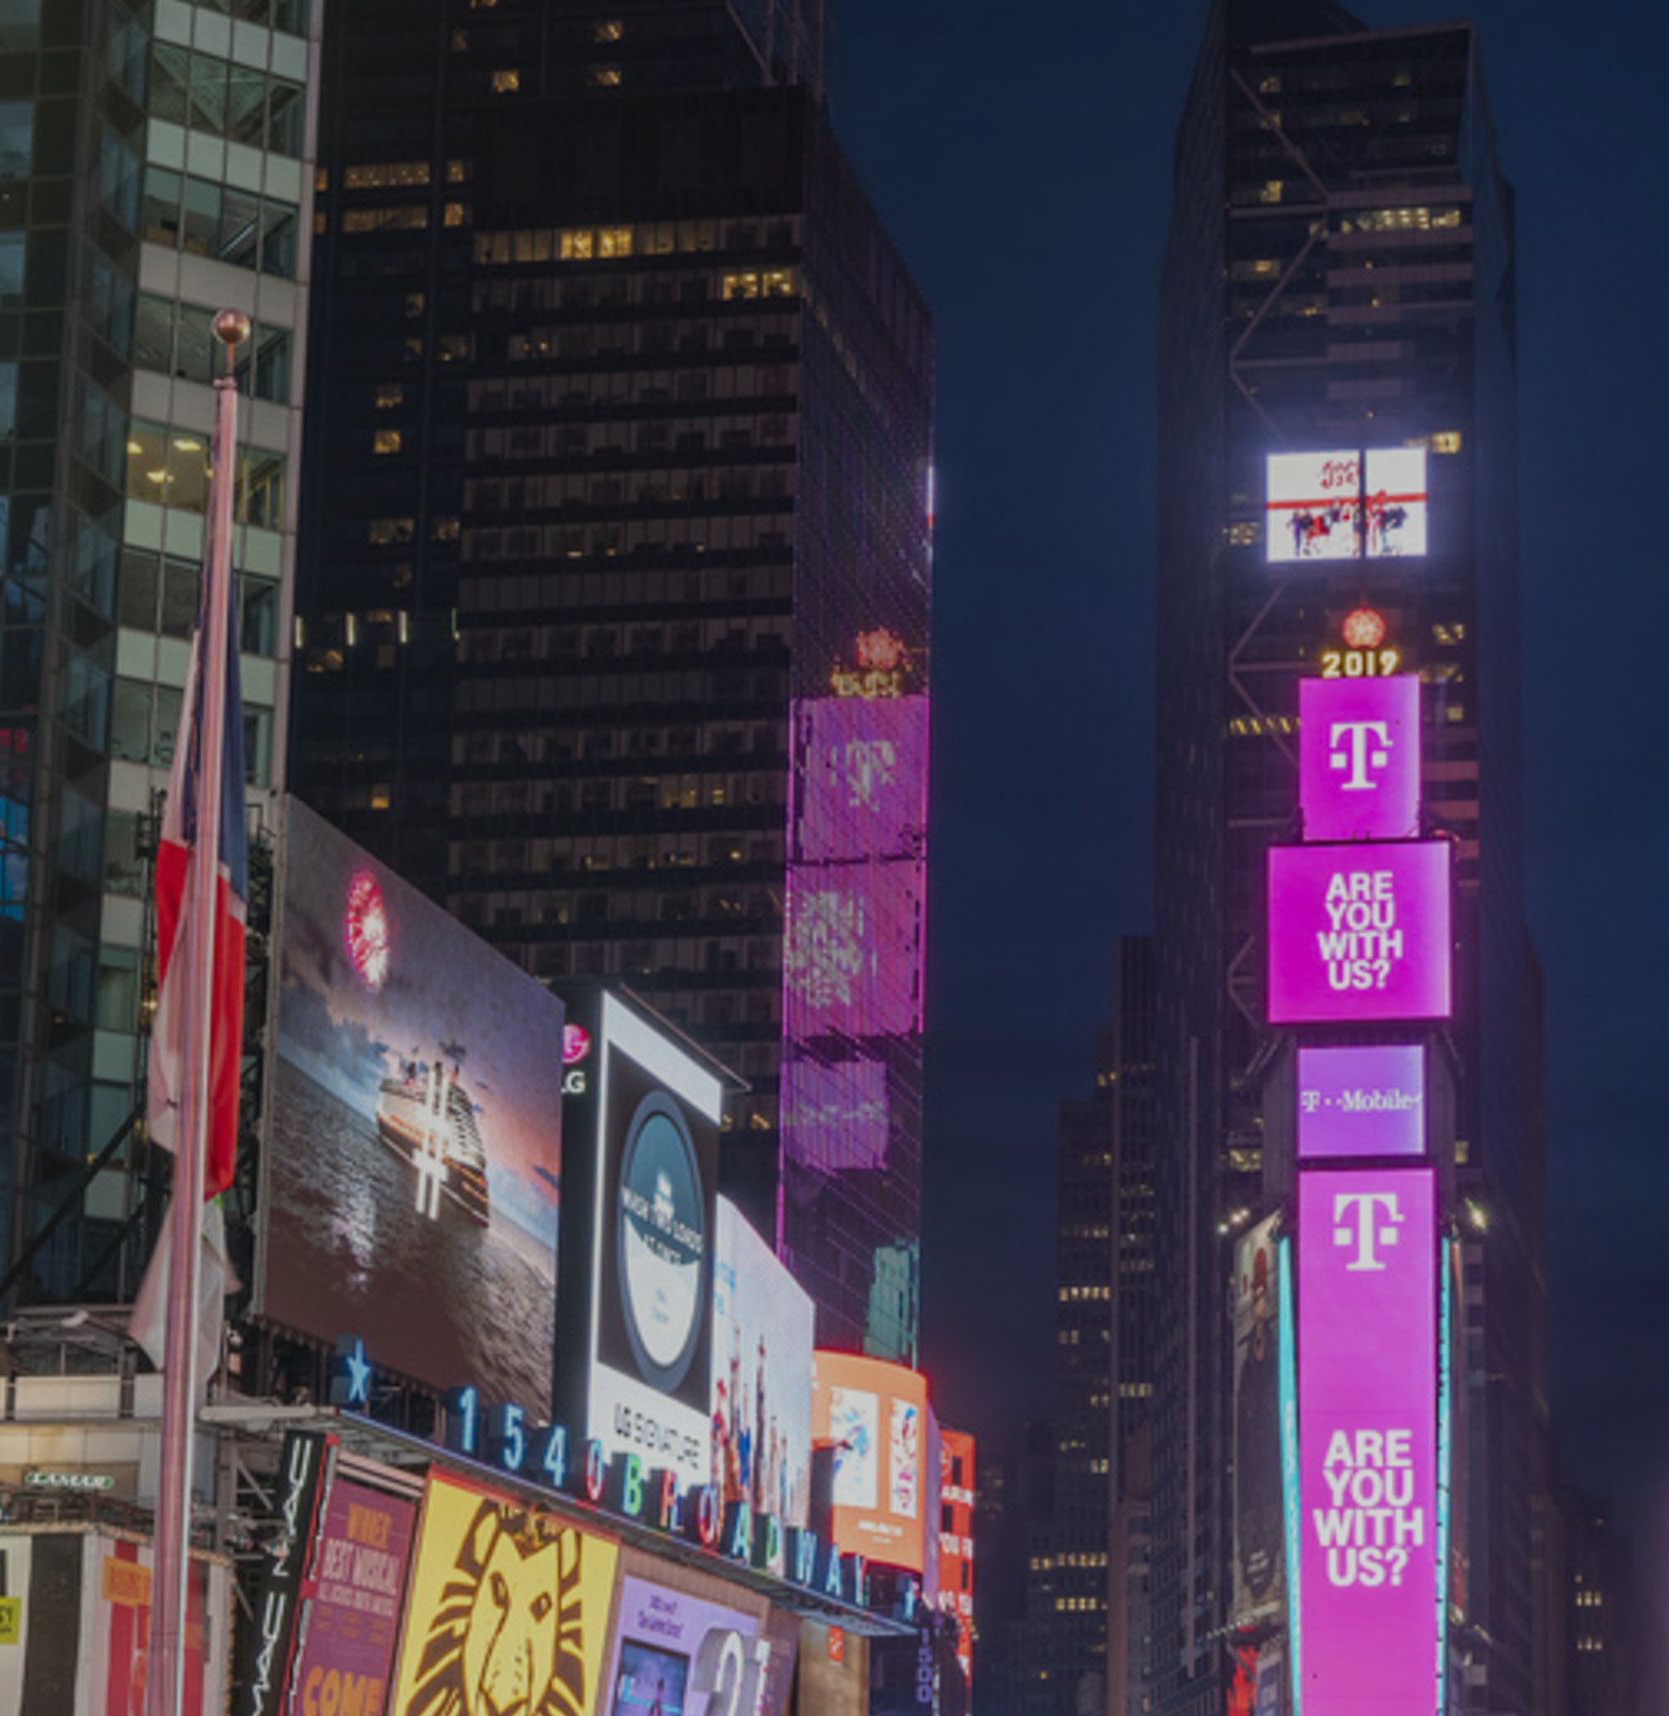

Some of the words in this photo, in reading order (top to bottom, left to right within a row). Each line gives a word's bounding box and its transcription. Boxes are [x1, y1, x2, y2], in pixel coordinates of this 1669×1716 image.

[1323, 652, 1399, 678] 2019
[1330, 720, 1393, 790] T
[1327, 872, 1394, 901] ARE
[1325, 902, 1395, 931] YOU
[1318, 930, 1403, 961] WITH
[1328, 959, 1391, 991] US?
[1333, 1193, 1405, 1271] T
[1324, 1430, 1412, 1469] ARE
[1323, 1469, 1413, 1508] YOU
[1313, 1508, 1424, 1547] WITH
[1327, 1549, 1408, 1587] US?
